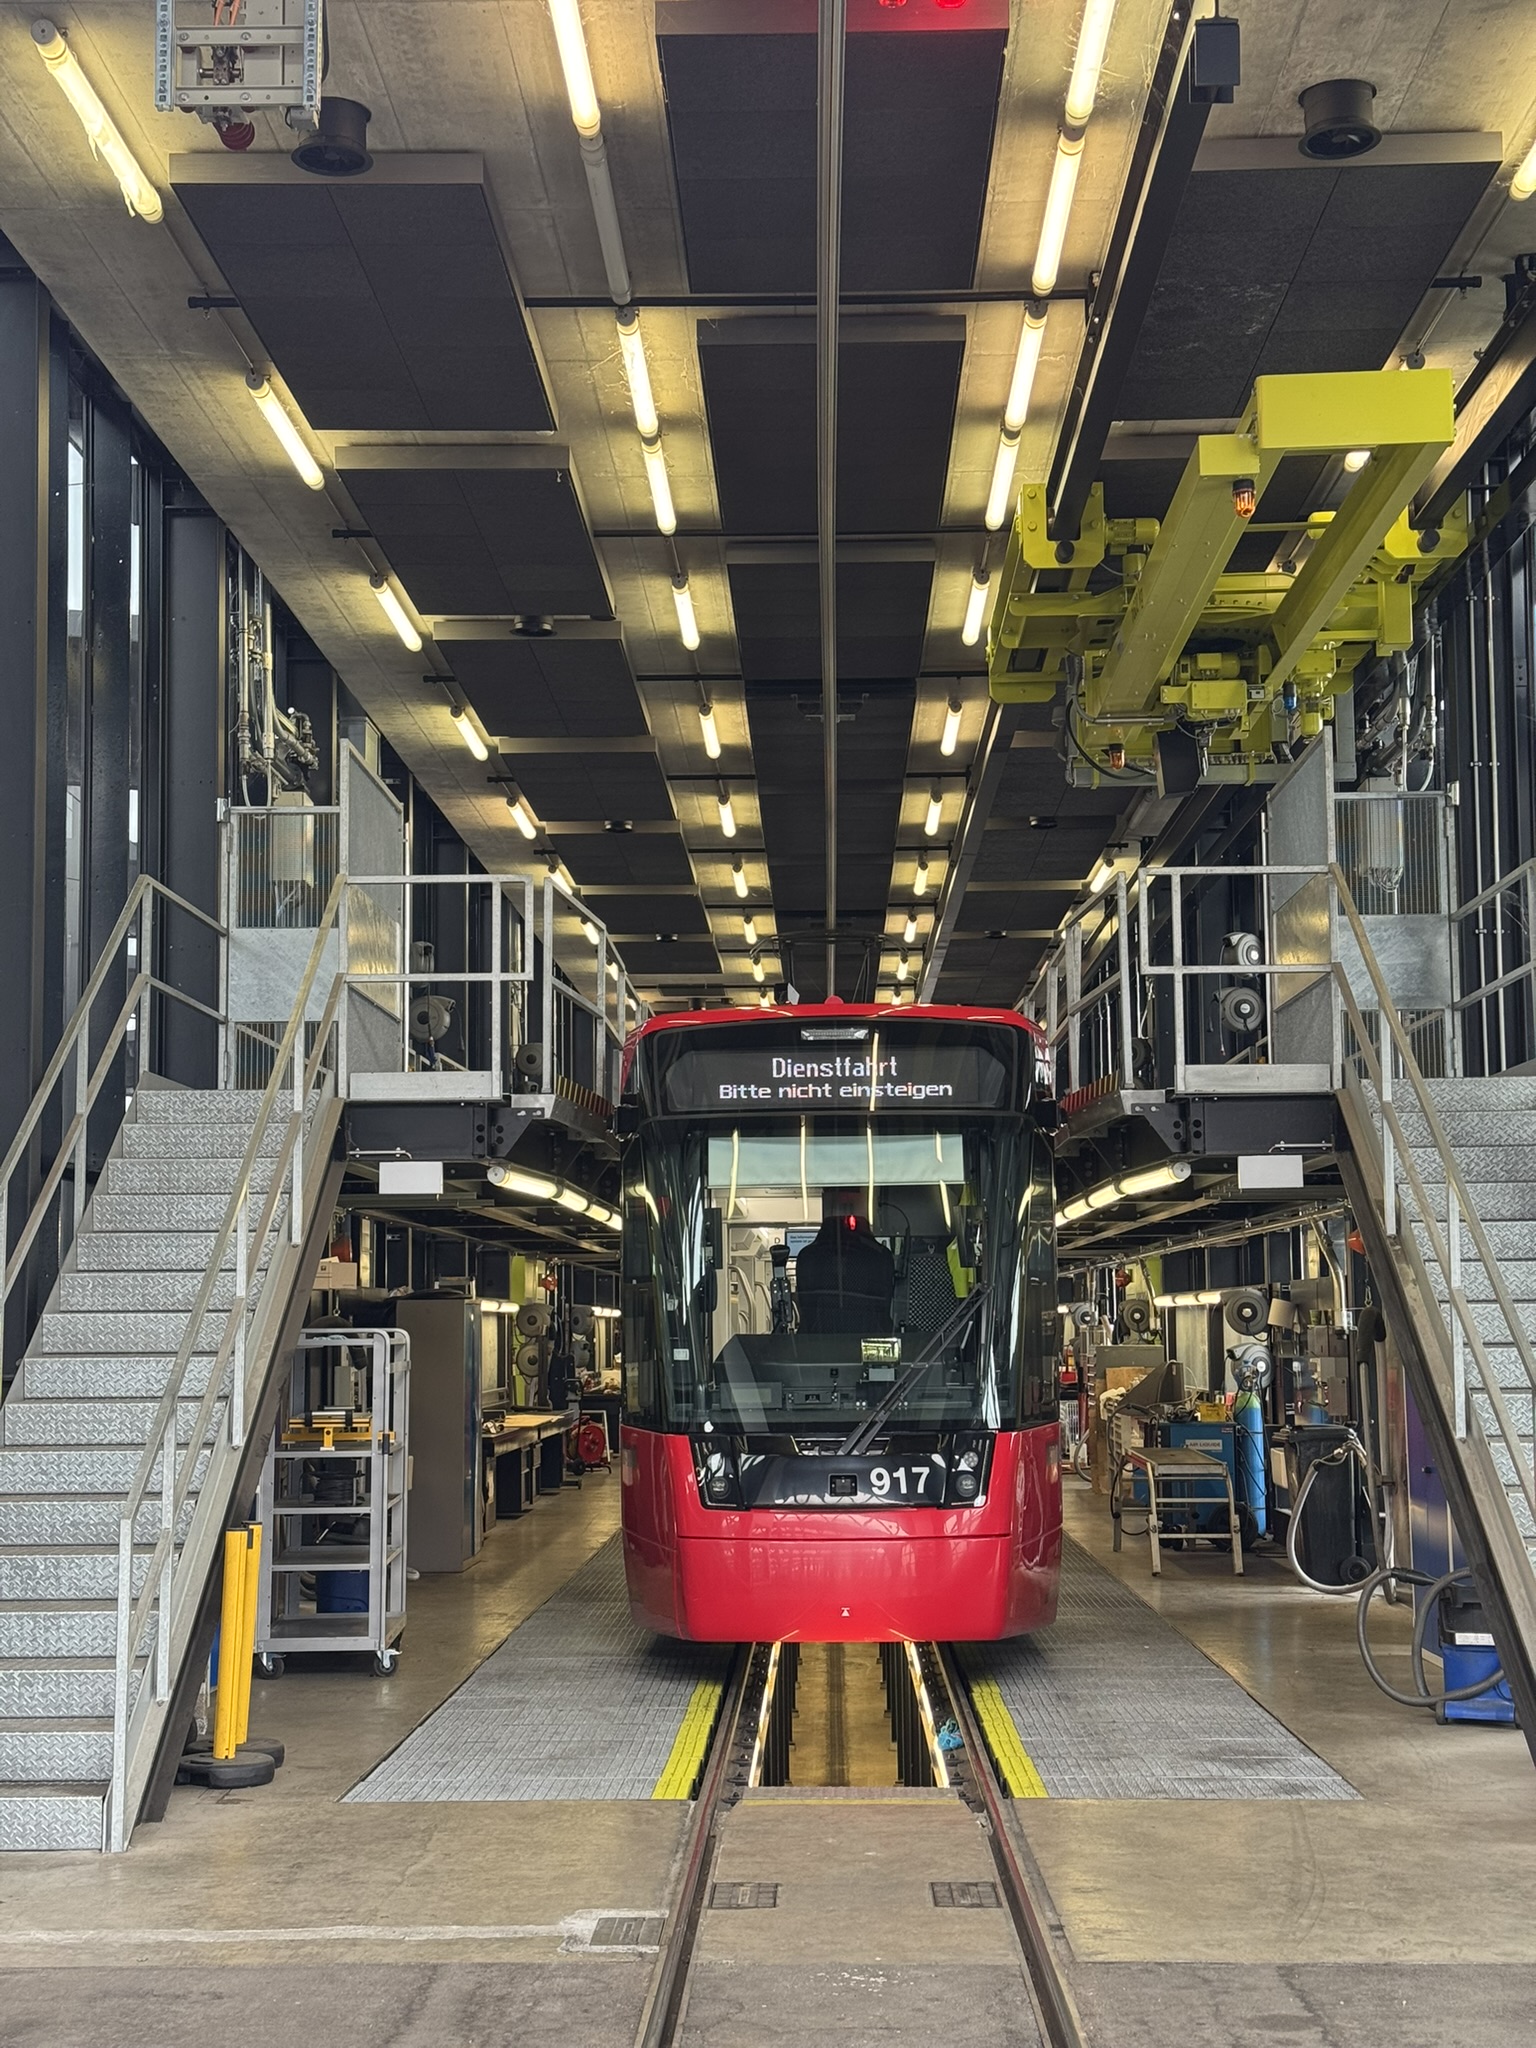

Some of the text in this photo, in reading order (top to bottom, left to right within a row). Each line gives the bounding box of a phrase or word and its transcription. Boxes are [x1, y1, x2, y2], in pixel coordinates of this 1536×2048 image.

[772, 1056, 897, 1078] Dienstfahrt
[719, 1082, 953, 1099] Bitte nicht einsteigen
[869, 1466, 930, 1495] 917
